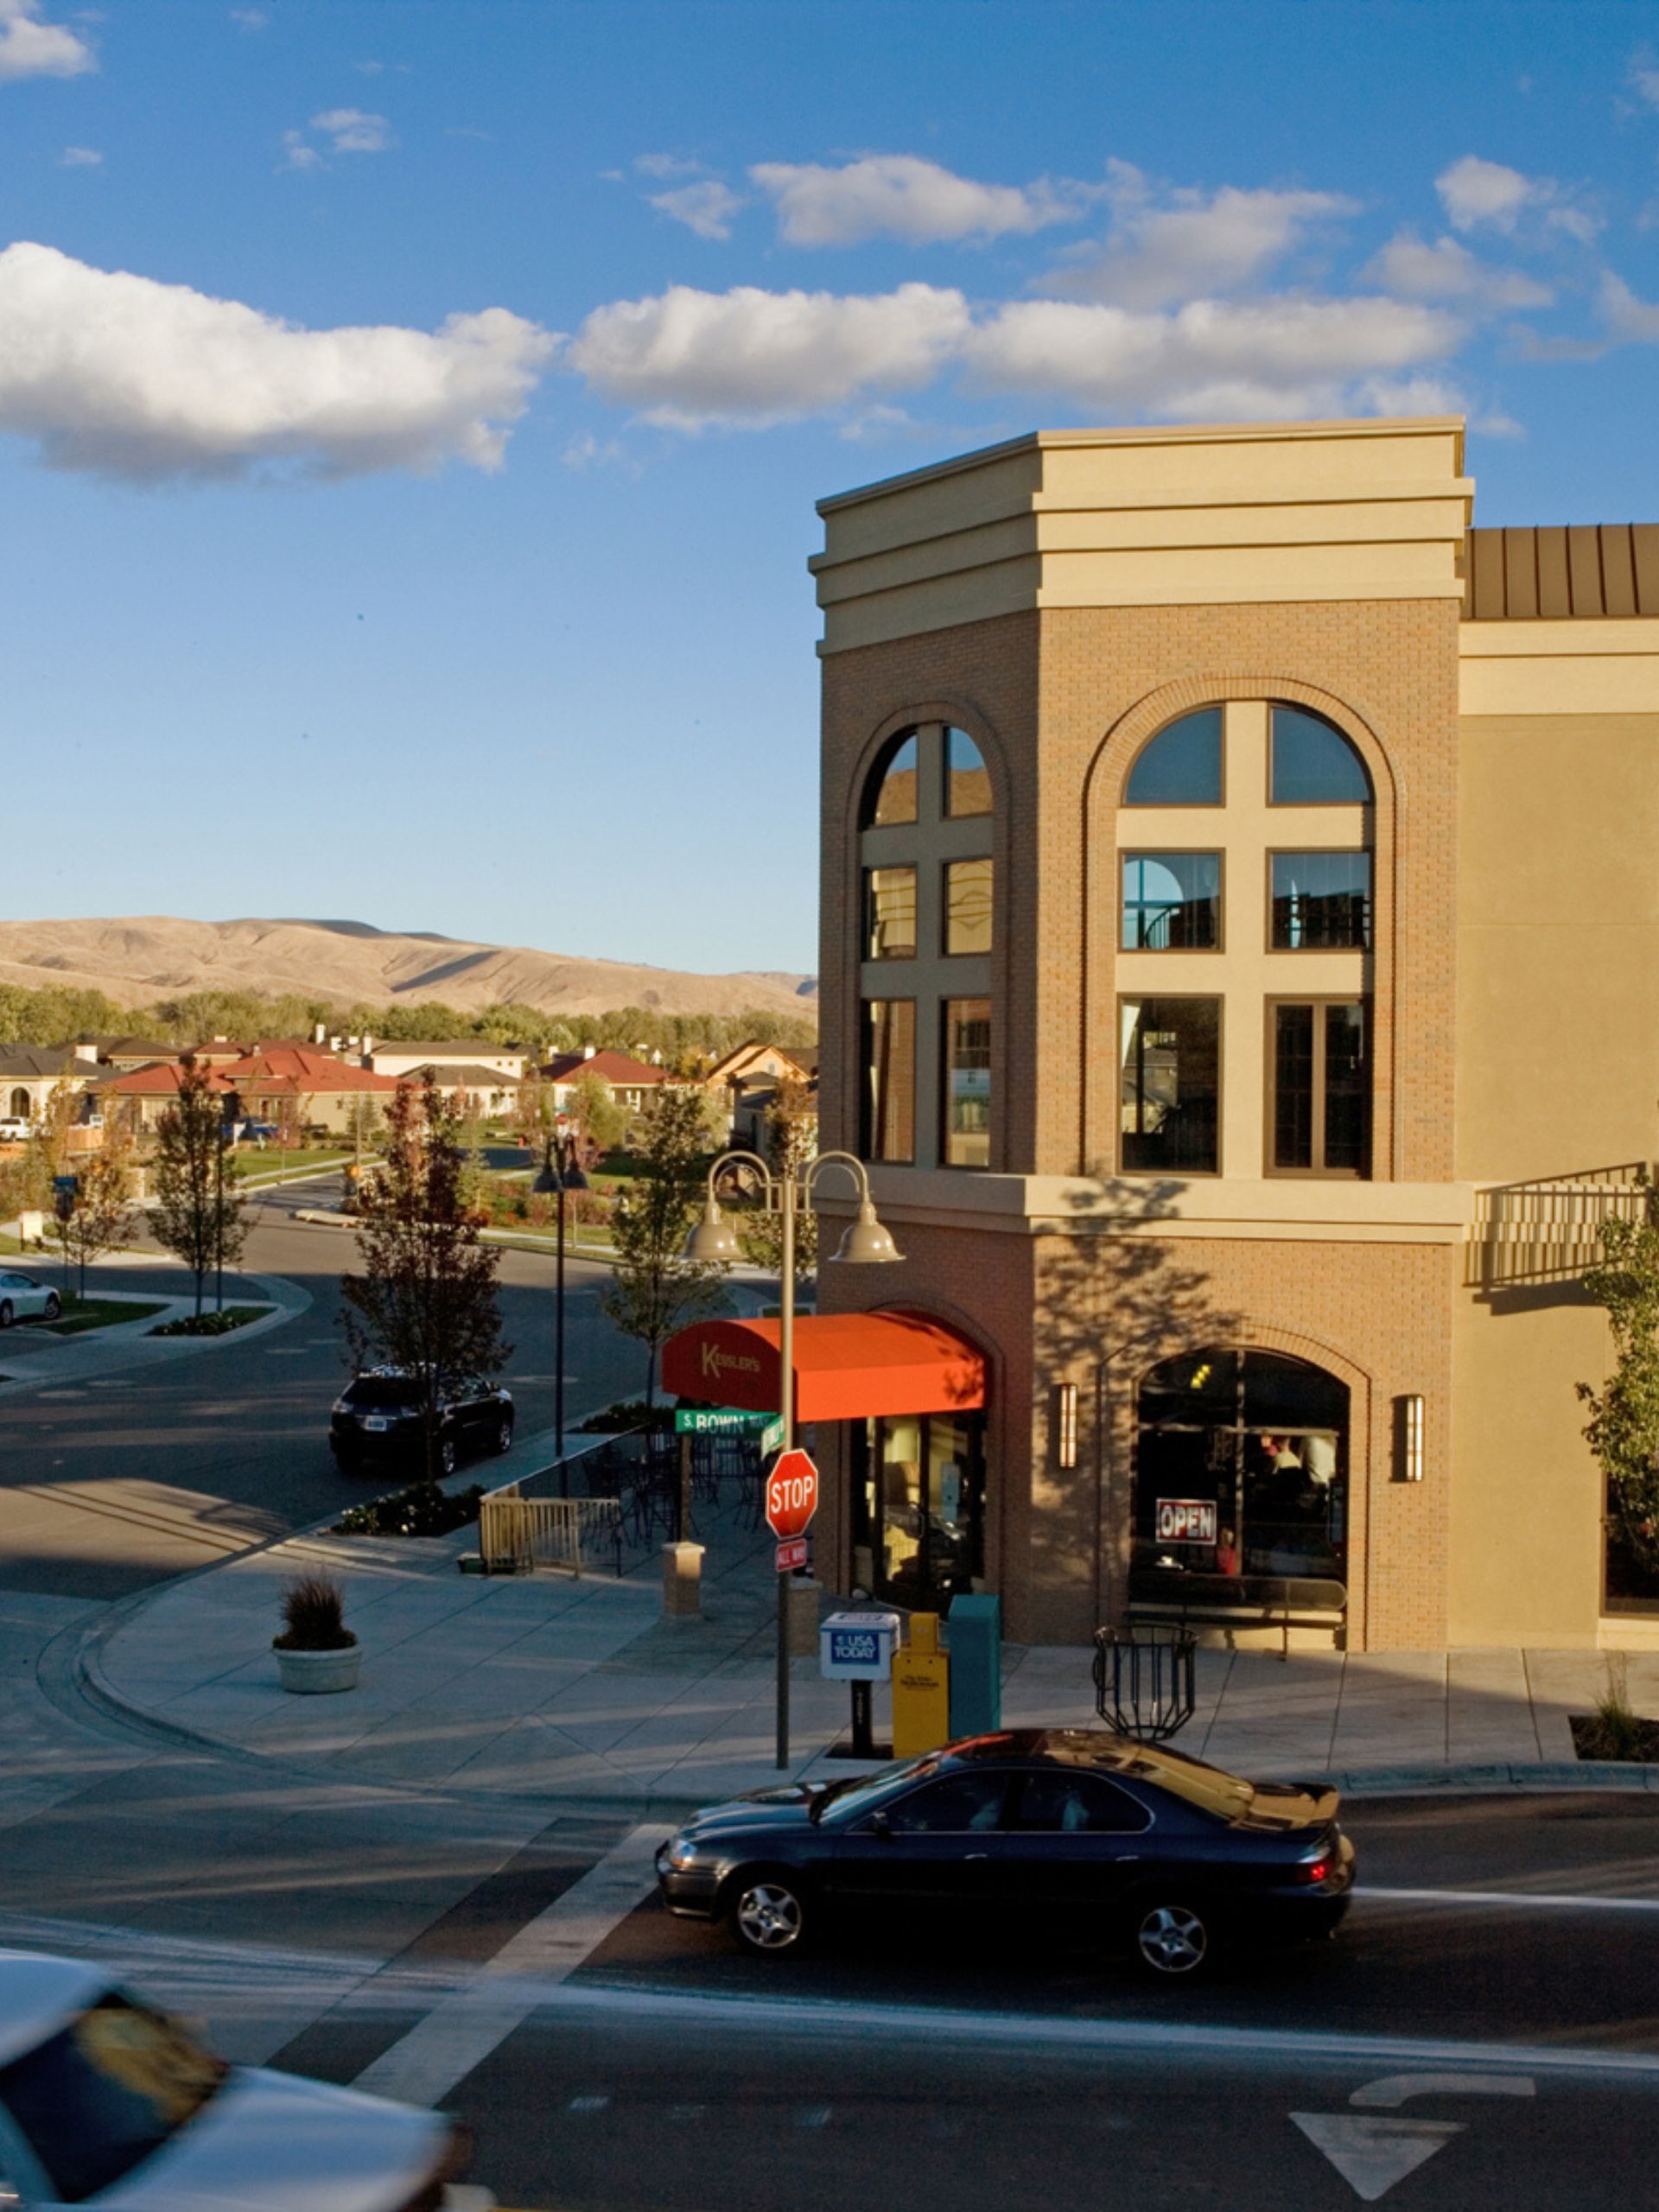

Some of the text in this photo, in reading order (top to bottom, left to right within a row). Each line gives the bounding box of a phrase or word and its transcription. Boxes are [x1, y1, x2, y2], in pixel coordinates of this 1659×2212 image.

[683, 1413, 693, 1428] S.
[696, 1414, 744, 1434] BOWN
[770, 1475, 814, 1515] STOP
[1160, 1504, 1211, 1537] OPEN
[848, 1635, 874, 1646] USA
[834, 1645, 876, 1659] TODAY
